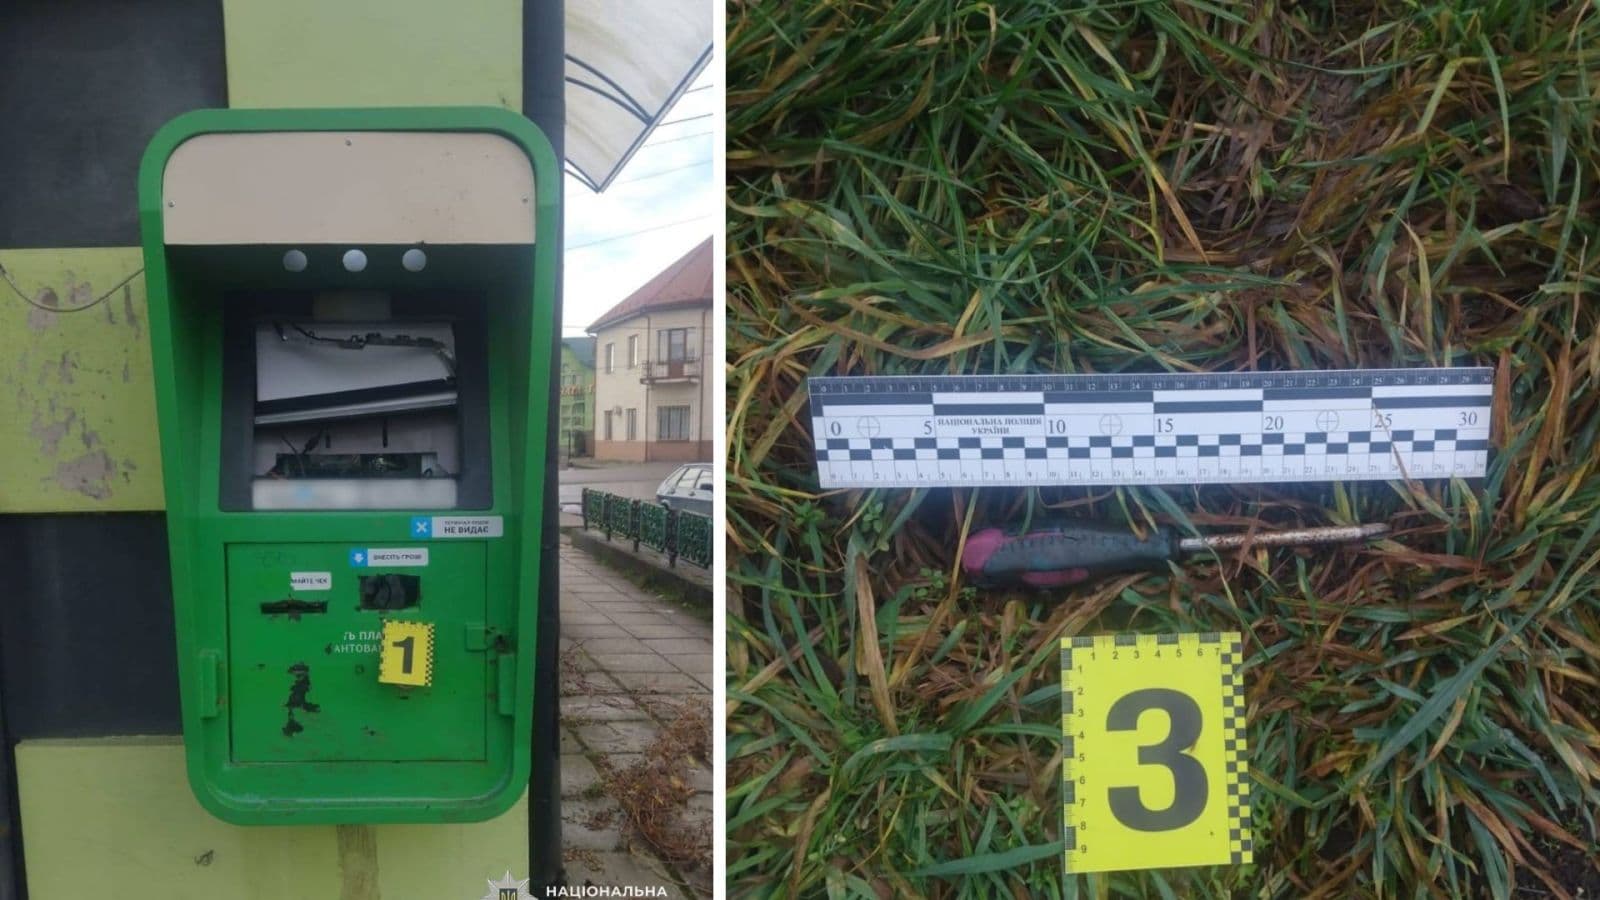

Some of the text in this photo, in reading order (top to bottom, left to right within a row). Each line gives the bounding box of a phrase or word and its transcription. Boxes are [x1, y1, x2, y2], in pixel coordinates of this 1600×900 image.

[830, 410, 1478, 436] 0 5 10 15 20 25 30
[938, 418, 1003, 427] НАЦІОНАЛЬНА
[971, 426, 1010, 435] УКРАЇНИ
[444, 526, 456, 534] НЕ
[392, 636, 414, 674] 1
[1091, 648, 1220, 660] 1 2 3 4 5 6 7
[1078, 665, 1082, 673] 1
[1078, 687, 1084, 695] 2
[1078, 708, 1084, 717] 3
[1078, 731, 1084, 739] 4
[1079, 754, 1085, 762] 5
[1106, 688, 1208, 832] 3
[1080, 776, 1086, 784] 6
[1080, 798, 1086, 807] 7
[1080, 821, 1086, 830] 8
[1080, 844, 1087, 853] 9
